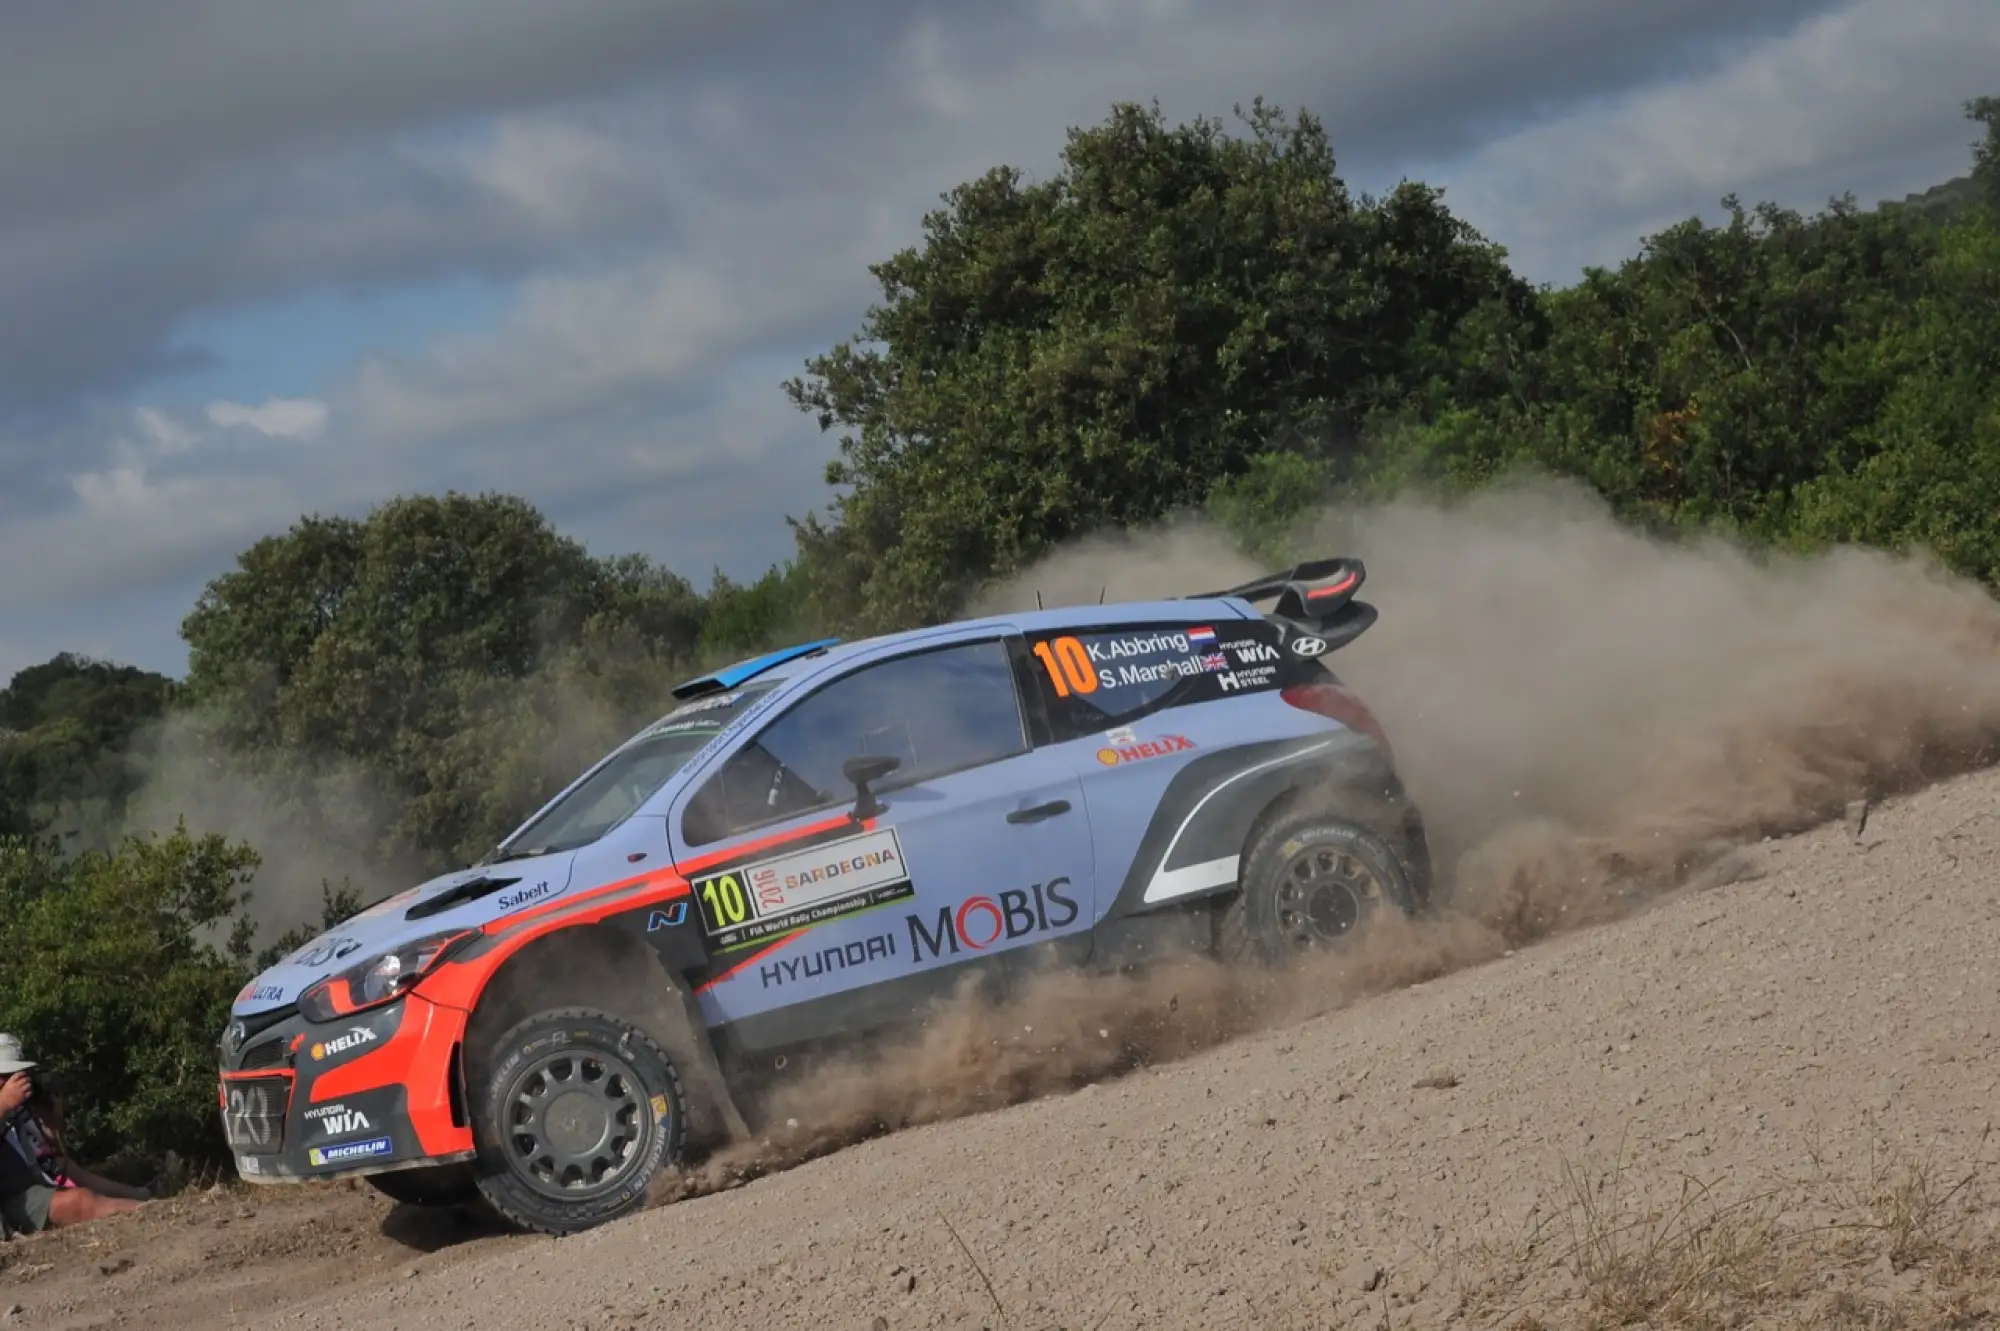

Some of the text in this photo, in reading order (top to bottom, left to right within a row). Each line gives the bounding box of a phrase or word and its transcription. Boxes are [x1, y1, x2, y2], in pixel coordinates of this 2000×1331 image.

[1086, 633, 1190, 662] K.Abbring
[1033, 635, 1098, 698] 10
[1099, 655, 1204, 690] S.Marshall
[1119, 734, 1199, 763] HELIX
[785, 848, 896, 890] SARDEGNA
[498, 880, 551, 910] Sabelt
[703, 873, 747, 928] 10
[754, 869, 785, 909] 2016
[764, 918, 789, 934] World
[790, 912, 810, 925] Rally
[810, 896, 867, 919] Championship
[905, 876, 1079, 964] MOBIS
[760, 932, 896, 988] HYUNDAI
[324, 1026, 377, 1056] HELIX
[304, 1103, 346, 1120] HYUNDAI
[327, 1139, 387, 1159] MICHELIN
